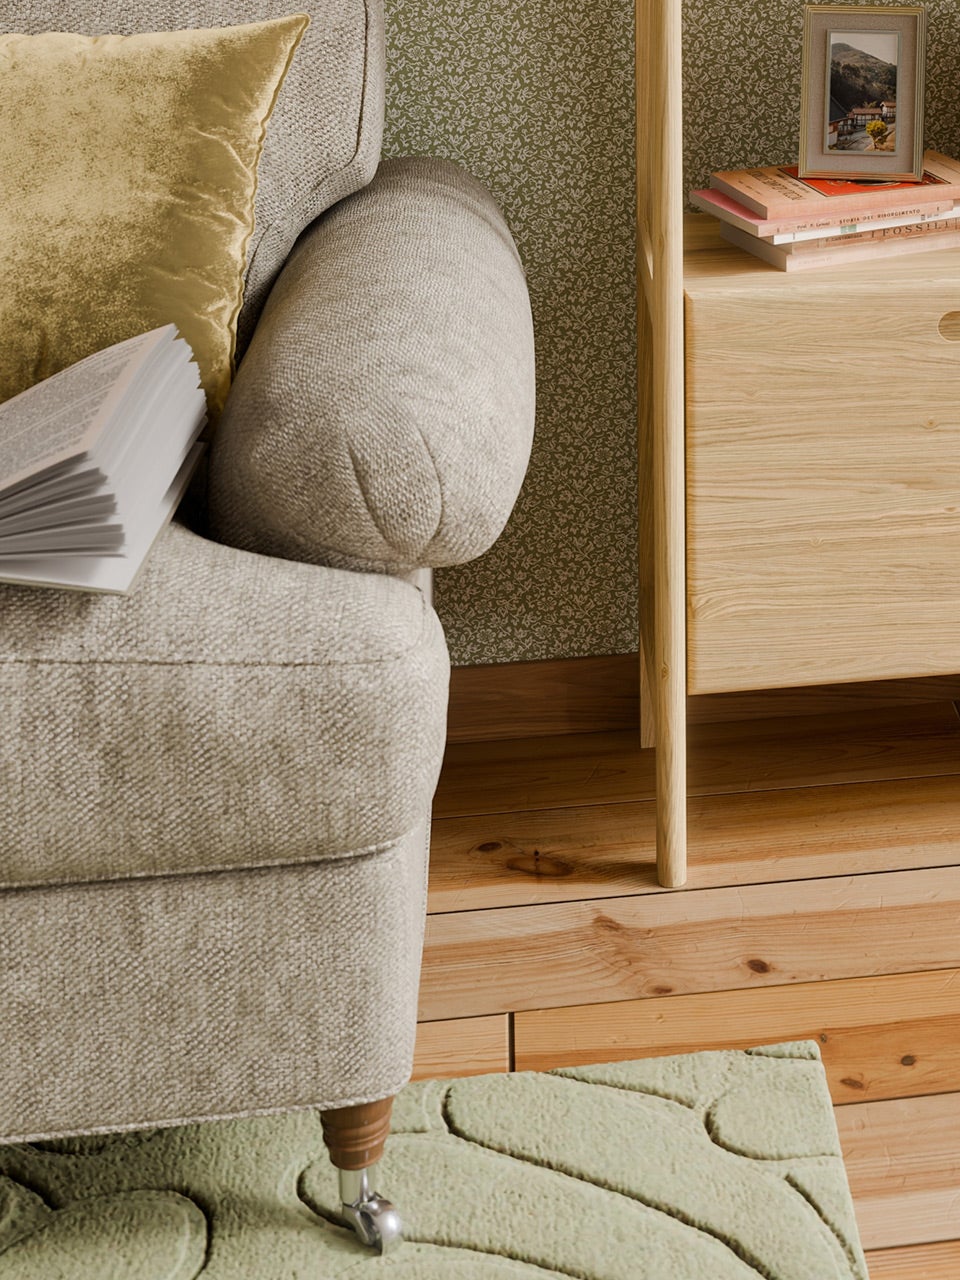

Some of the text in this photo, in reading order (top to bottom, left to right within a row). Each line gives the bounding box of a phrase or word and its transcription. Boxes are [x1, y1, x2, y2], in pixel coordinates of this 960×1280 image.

[877, 209, 921, 219] RISORGIMENTO
[871, 230, 875, 239] I
[882, 220, 949, 237] FOSSILI
